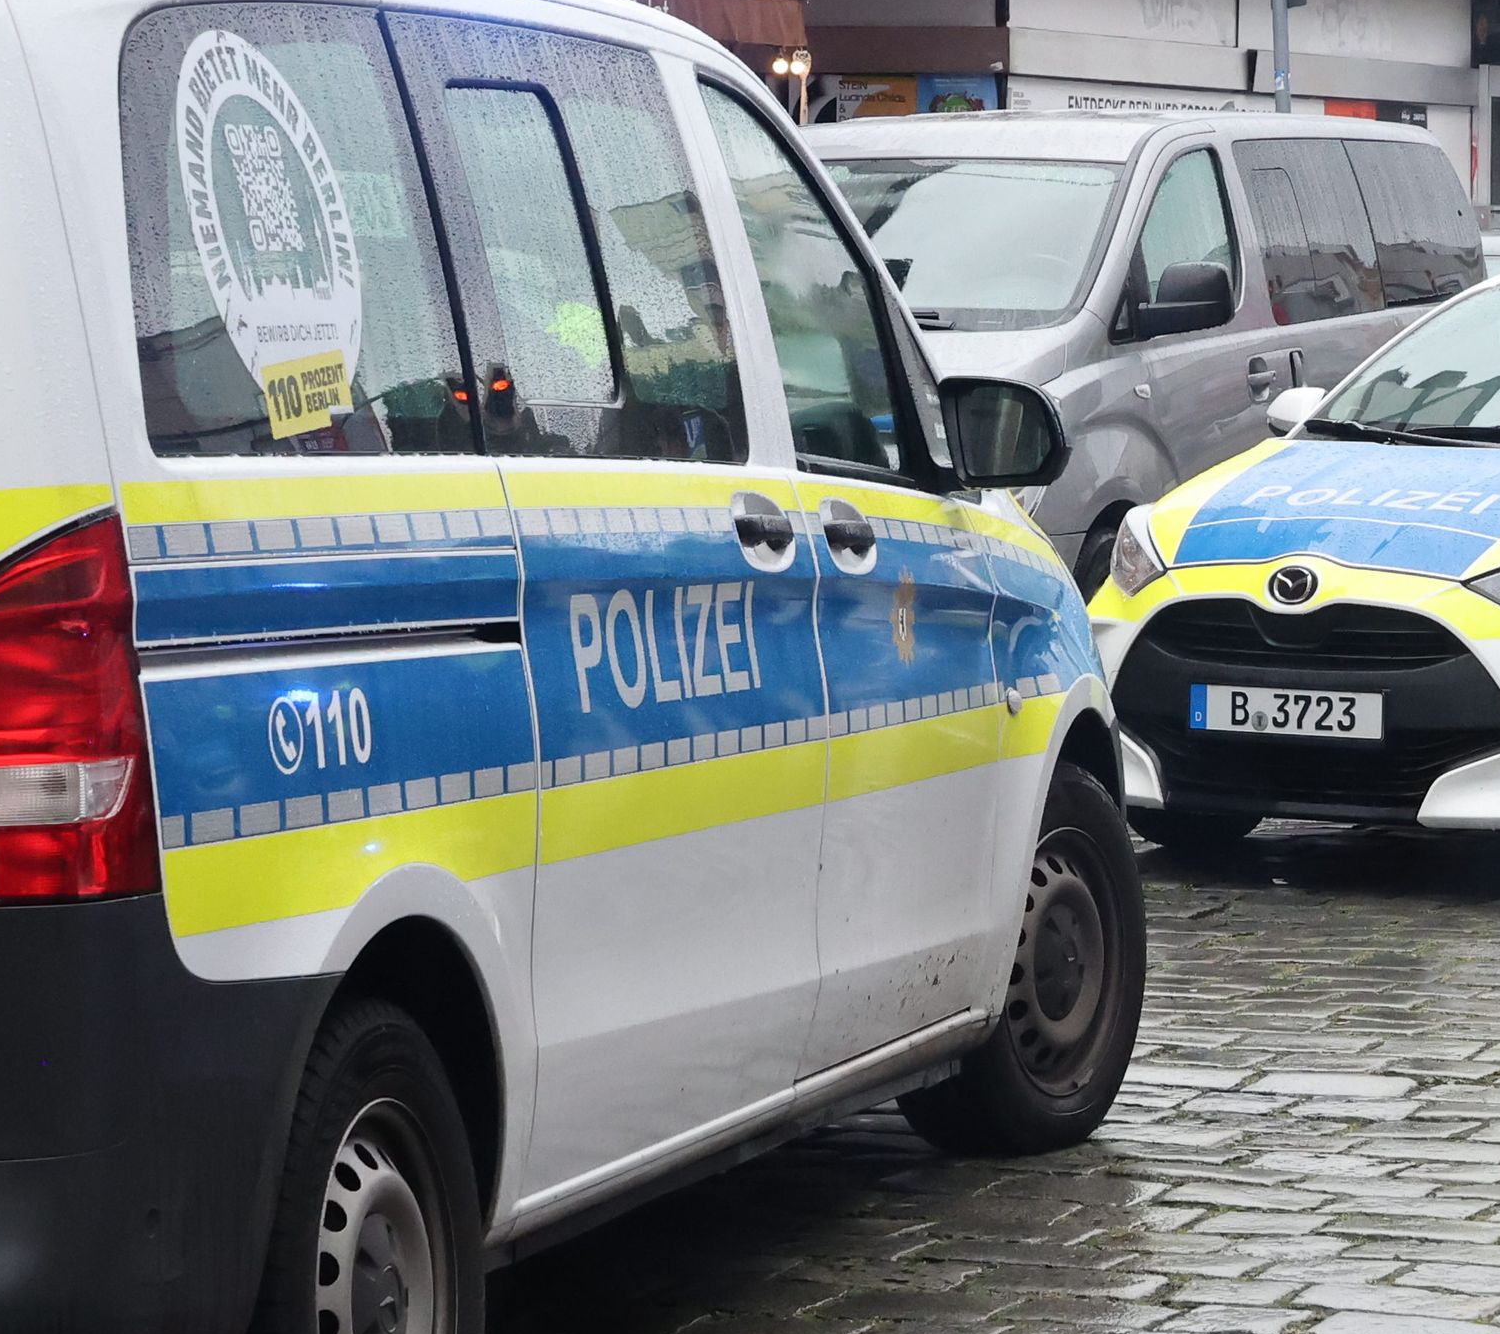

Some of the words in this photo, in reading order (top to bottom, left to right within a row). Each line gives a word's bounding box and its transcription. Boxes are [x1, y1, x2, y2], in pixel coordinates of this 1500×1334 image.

[187, 44, 244, 119] BIETET
[244, 50, 299, 131] MEHR
[838, 80, 869, 90] STEIN
[184, 102, 233, 291] NIEMAND
[267, 373, 304, 421] 110
[300, 361, 345, 392] PROZENT
[303, 385, 341, 415] BERLIN
[568, 581, 764, 716] POLIZEI
[302, 686, 372, 772] 110
[1230, 691, 1250, 727] B
[1271, 693, 1358, 733] 3723
